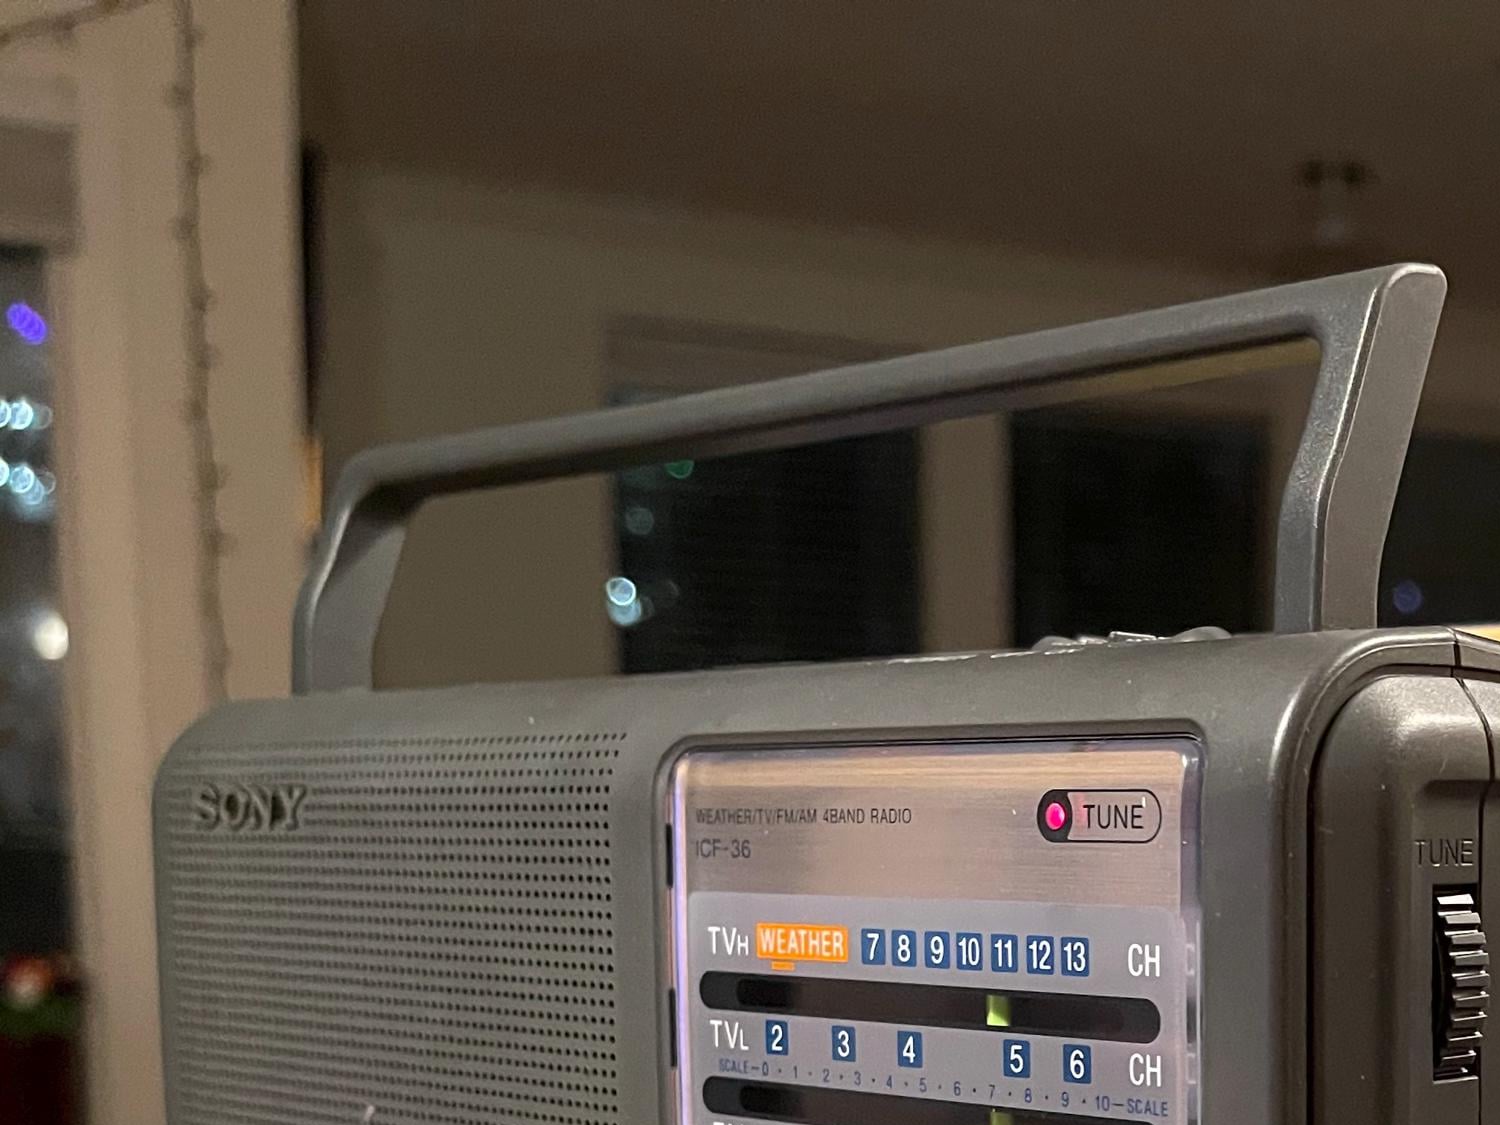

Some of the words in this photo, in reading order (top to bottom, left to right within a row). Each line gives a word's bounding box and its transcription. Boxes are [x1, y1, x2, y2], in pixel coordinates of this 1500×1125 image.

[194, 782, 307, 831] SONY
[822, 807, 866, 825] 4BAND
[869, 807, 912, 825] RADIO
[1082, 804, 1145, 830] TUNE
[695, 838, 752, 859] ICF-36
[1413, 838, 1474, 867] TUNE
[760, 927, 845, 957] WEATHER
[866, 932, 880, 961] 7
[897, 934, 911, 962] 8
[930, 935, 945, 964] 9
[958, 937, 980, 966] 10
[994, 939, 1013, 968] 11
[1028, 940, 1052, 970] 12
[1063, 941, 1087, 972] 13
[1127, 943, 1161, 977] CH
[770, 1024, 783, 1051] 2
[837, 1030, 850, 1057] 3
[902, 1035, 916, 1064] 4
[1009, 1044, 1024, 1073] 5
[1069, 1049, 1085, 1079] 6
[1129, 1053, 1162, 1088] CH
[822, 1068, 831, 1083] 2
[853, 1071, 862, 1086] 3
[885, 1074, 894, 1089] 4
[918, 1077, 928, 1093] 5
[953, 1081, 962, 1097] 6
[988, 1084, 996, 1100] 7
[1024, 1087, 1033, 1103] 8
[1061, 1091, 1070, 1108] 9
